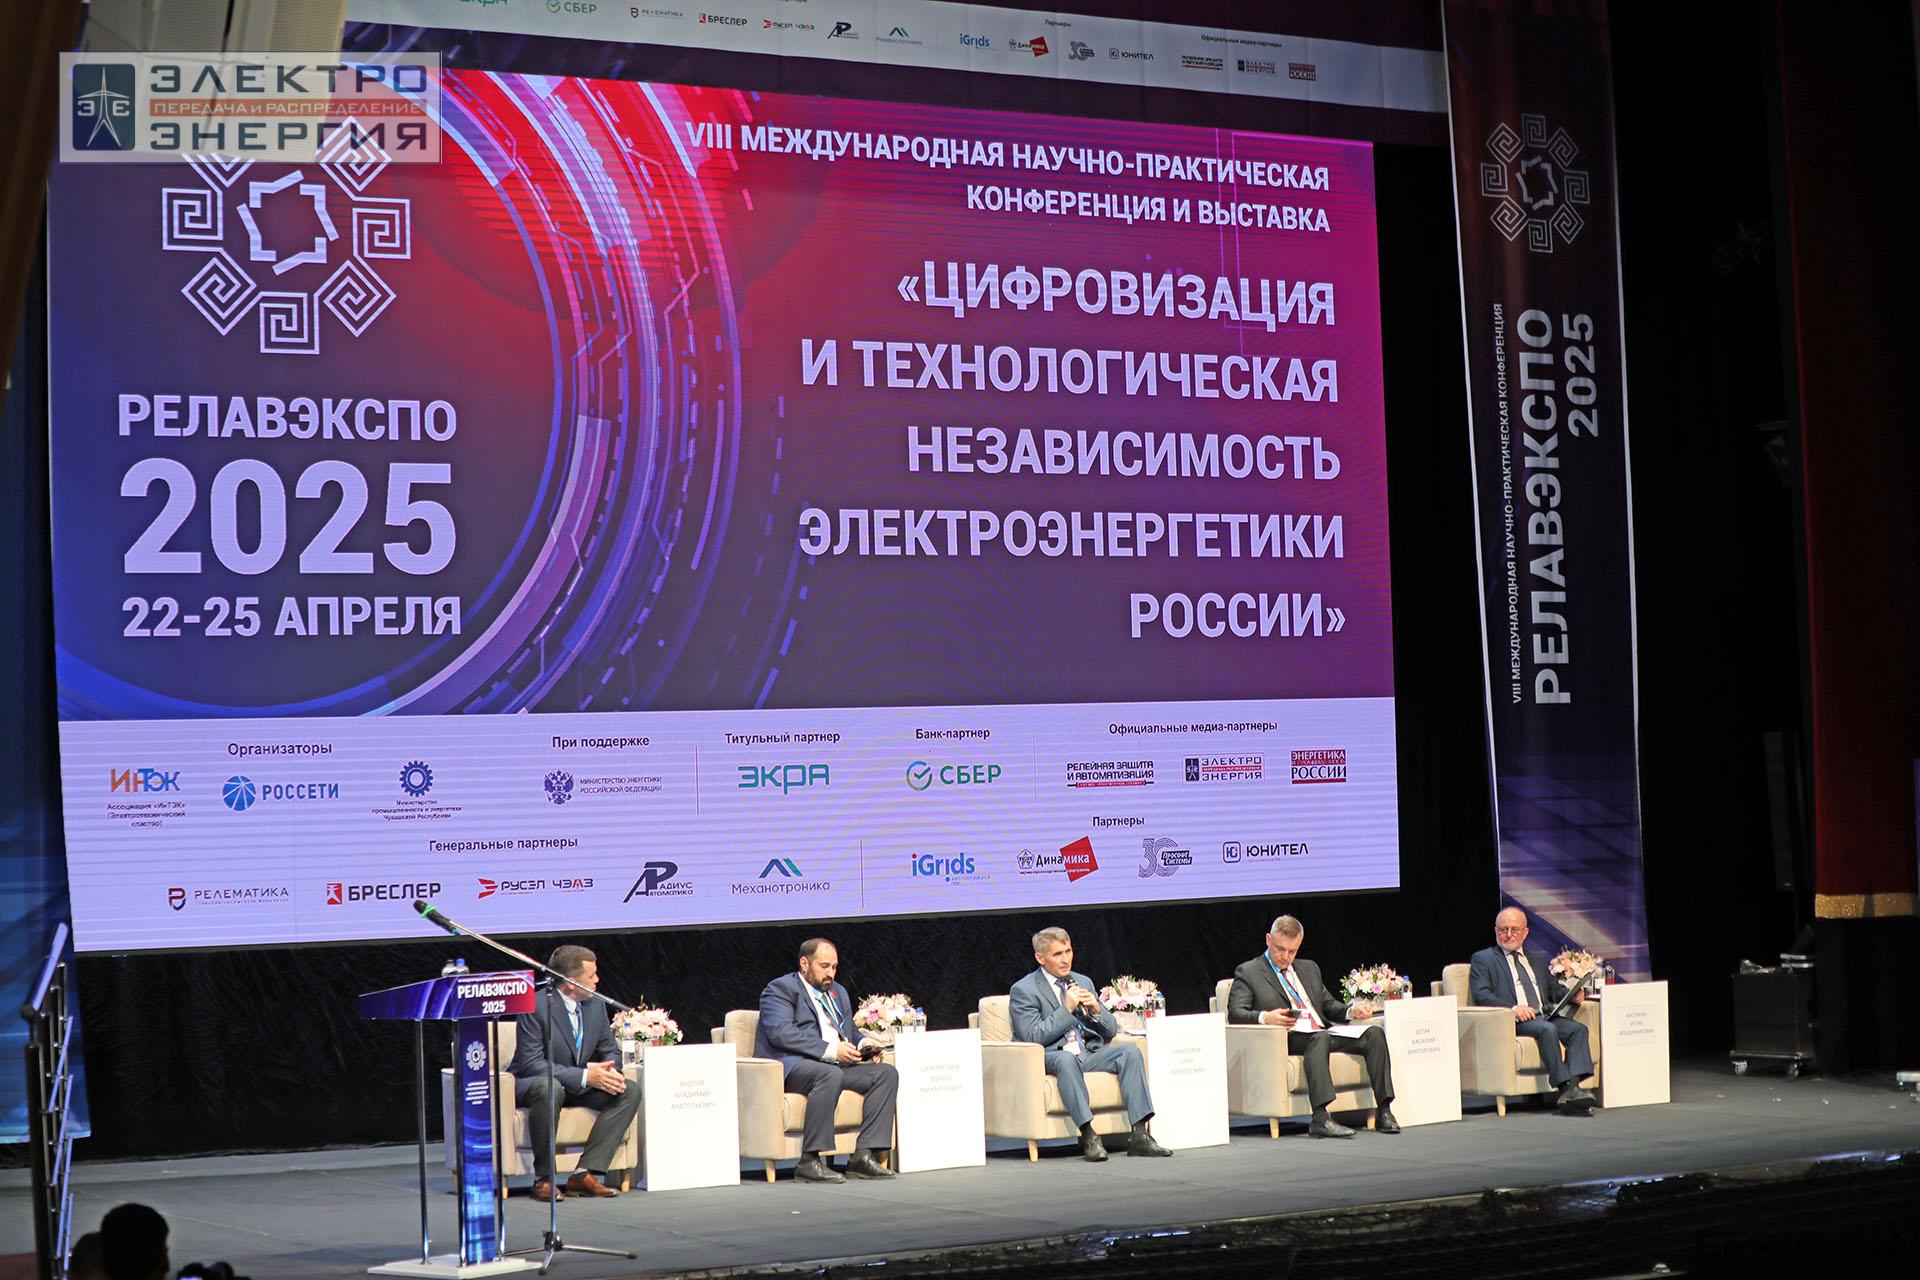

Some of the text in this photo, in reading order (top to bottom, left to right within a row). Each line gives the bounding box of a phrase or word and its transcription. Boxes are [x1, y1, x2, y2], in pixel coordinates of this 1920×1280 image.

[563, 2, 597, 13] СБЕР
[708, 15, 747, 27] БРЕСЛЕР
[960, 33, 990, 49] iGrids
[1121, 51, 1154, 61] ЮНИТЕЛ
[686, 122, 1330, 192] VIII МЕЖДУНАРОДНАЯ НАУЧНО-ПРАКТИЧЕСКАЯ
[966, 184, 1331, 233] КОНФЕРЕНЦИЯ И ВЫСТАВКА
[897, 259, 1336, 332] «ЦИФРОВИЗАЦИЯ
[801, 338, 1339, 402] И ТЕХНОЛОГИЧЕСКАЯ
[1562, 312, 1599, 438] 2025
[118, 393, 458, 442] РЕЛАВЭКСПО
[907, 425, 1342, 481] НЕЗАВИСИМОСТЬ
[1493, 303, 1521, 704] VIII МЕЖДУНАРОДНАЯ НАУЧНО-ПРАКТИЧЕСКАЯ КОНФЕРЕНЦИЯ
[1517, 308, 1571, 705] РЕЛАВЭКСПО
[120, 457, 456, 576] 2025
[799, 507, 1345, 558] ЭЛЕКТРОЭНЕРГЕТИКИ
[121, 595, 462, 638] 22-25 АПРЕЛЯ
[1130, 592, 1346, 639] РОССИИ»
[915, 728, 991, 741] Банк-партнер
[1109, 722, 1278, 736] Официальные медиа-партнеры
[552, 736, 650, 750] При поддержке
[725, 731, 841, 746] Титульный партнер
[228, 743, 333, 758] Организаторы
[1291, 750, 1345, 760] ЭНЕРГЕТИКА
[1066, 760, 1154, 771] РЕЛЕЙНАЯ ЗАЩИТА
[1201, 756, 1262, 766] ЭЛЕКТРО
[939, 764, 1002, 785] СБЕР
[1067, 770, 1154, 781] И АВТОМАТИЗАЦИЯ
[1201, 772, 1262, 781] ЭНЕРГИЯ
[1291, 766, 1347, 780] РОССИИ
[262, 783, 339, 801] РОССЕТИ
[580, 785, 624, 794] РОССИЙСКОЙ
[1092, 816, 1145, 829] Партнеры
[429, 837, 578, 853] Генеральные партнеры
[1246, 843, 1309, 857] ЮНИТЕЛ
[911, 852, 976, 877] iGrids
[1035, 852, 1090, 868] Динамика
[348, 882, 441, 902] БРЕСЛЕР
[501, 879, 546, 891] РУСЭЛ
[731, 881, 831, 895] Механотроника
[194, 888, 289, 900] РЕЛЕМАТИКА
[458, 981, 528, 999] РЕЛАВЭКСПО
[482, 999, 506, 1014] 2025
